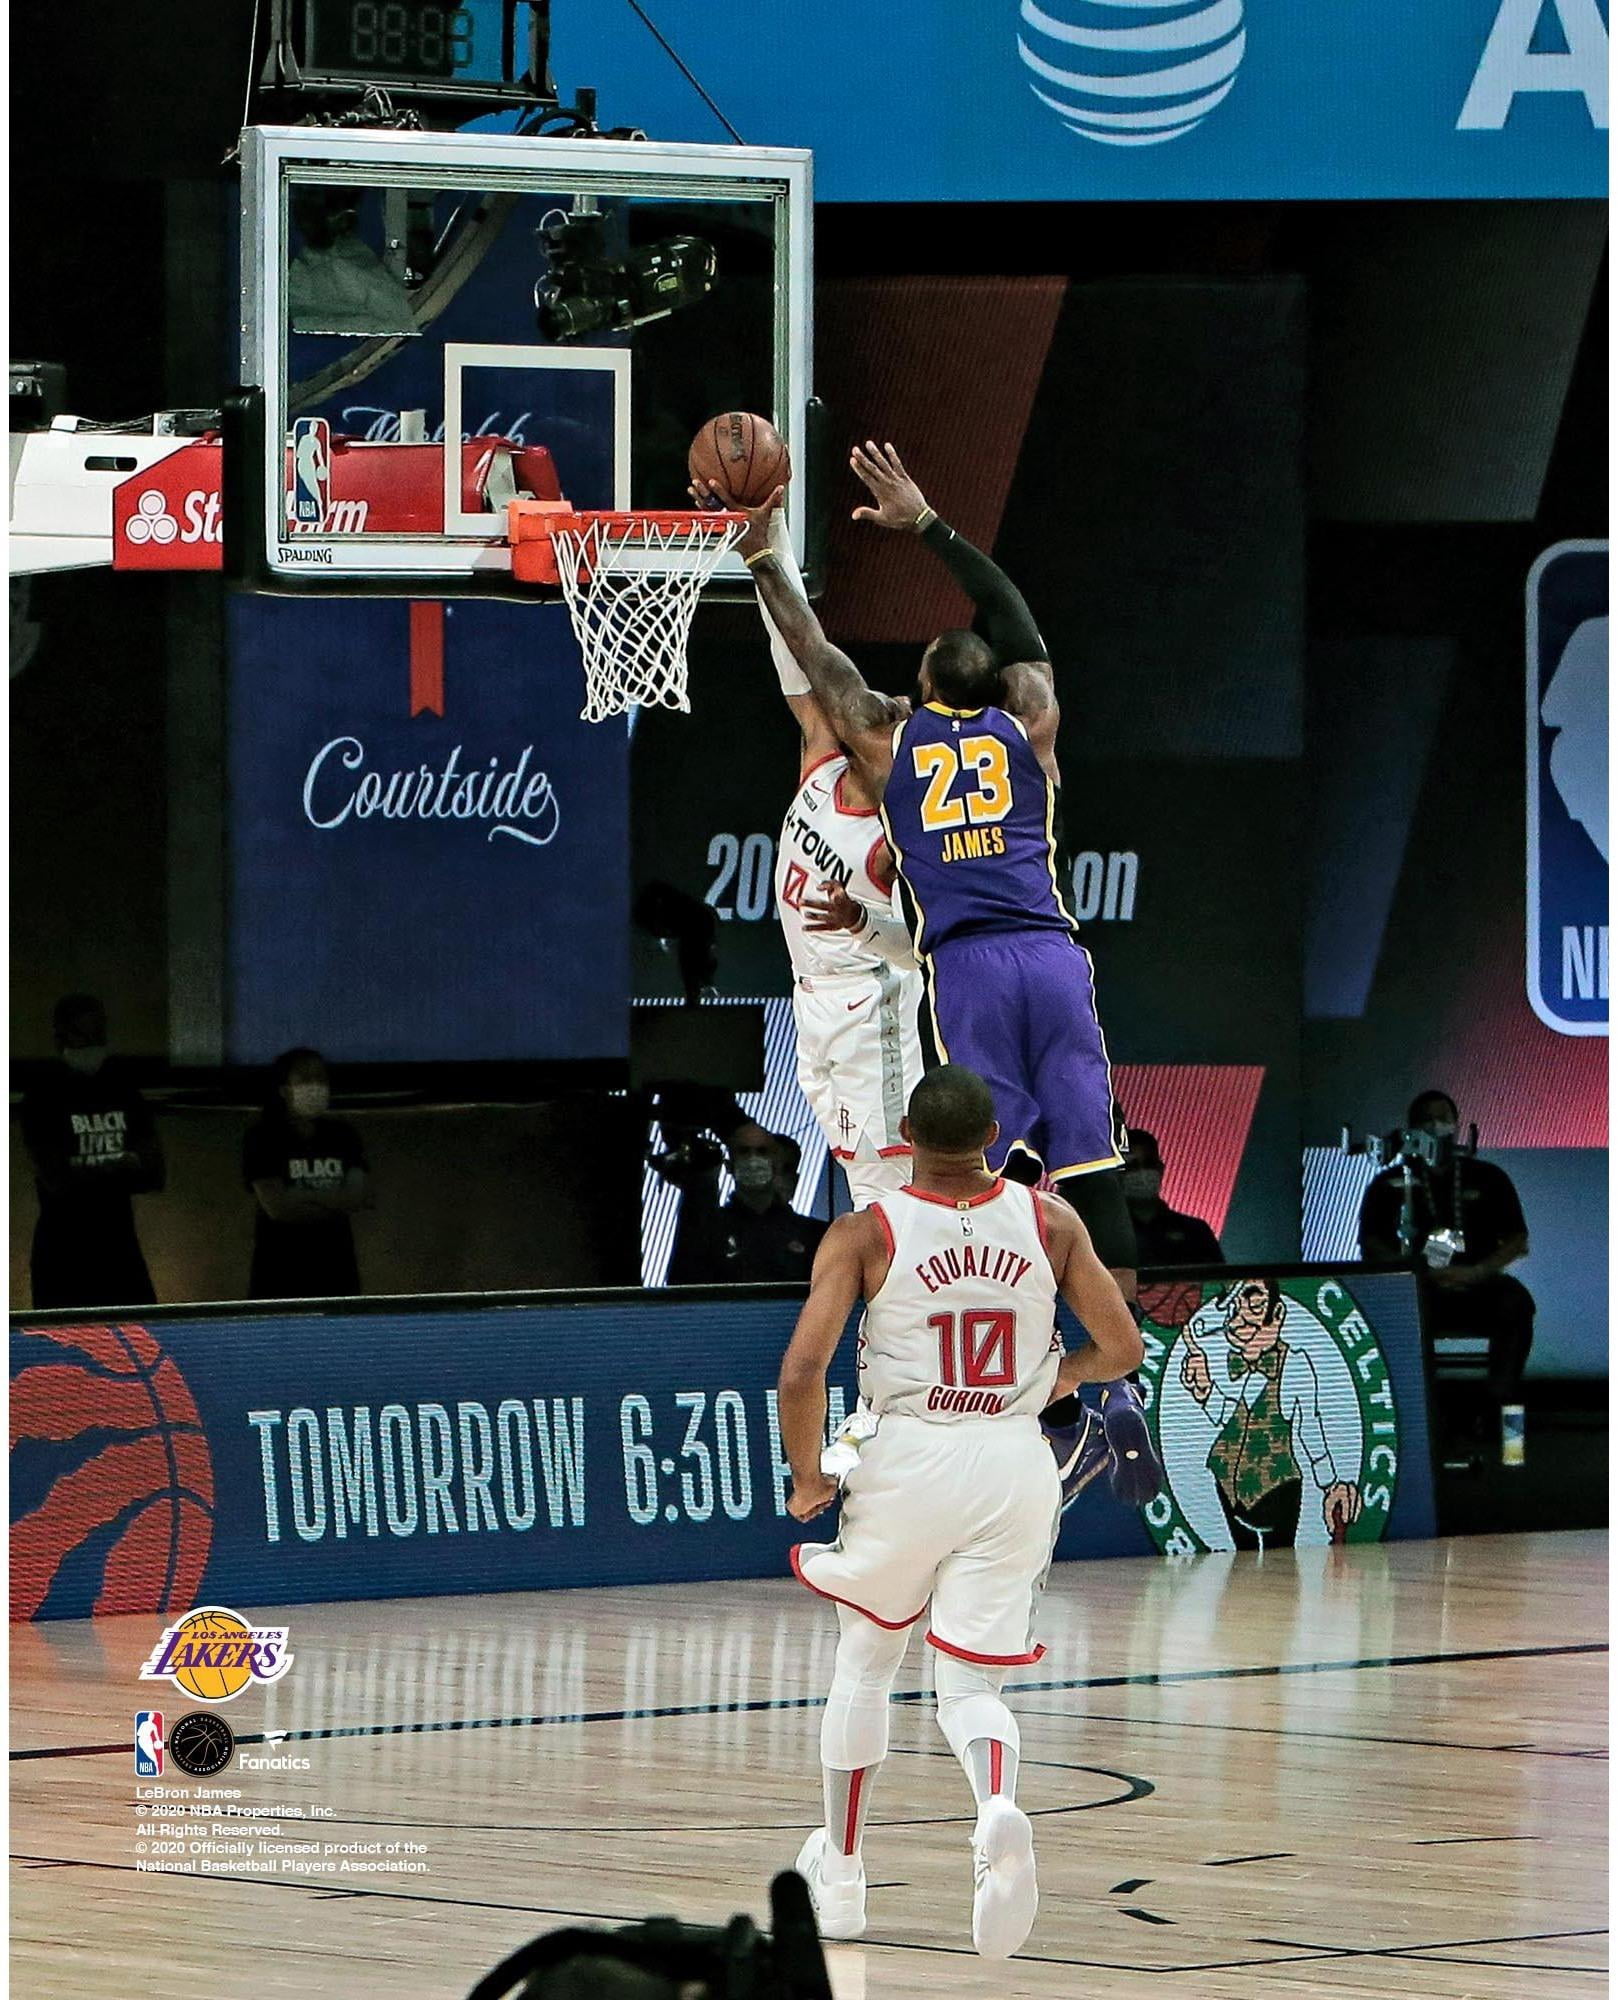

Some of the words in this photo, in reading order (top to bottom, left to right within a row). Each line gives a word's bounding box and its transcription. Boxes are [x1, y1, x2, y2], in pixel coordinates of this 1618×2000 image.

[277, 547, 332, 564] SPALDING
[302, 736, 560, 845] Courtside
[912, 734, 1015, 833] 23
[704, 832, 779, 921] 20
[1072, 850, 1139, 921] on
[940, 827, 1005, 864] JAMES
[71, 1111, 127, 1134] BLACK
[289, 1158, 342, 1179] BLACK
[915, 1245, 1032, 1294] EQUALITY
[926, 1308, 1017, 1388] 10
[1317, 1280, 1397, 1512] CELTICS
[247, 1396, 586, 1544] TOMORROW
[619, 1391, 753, 1526] 6:30
